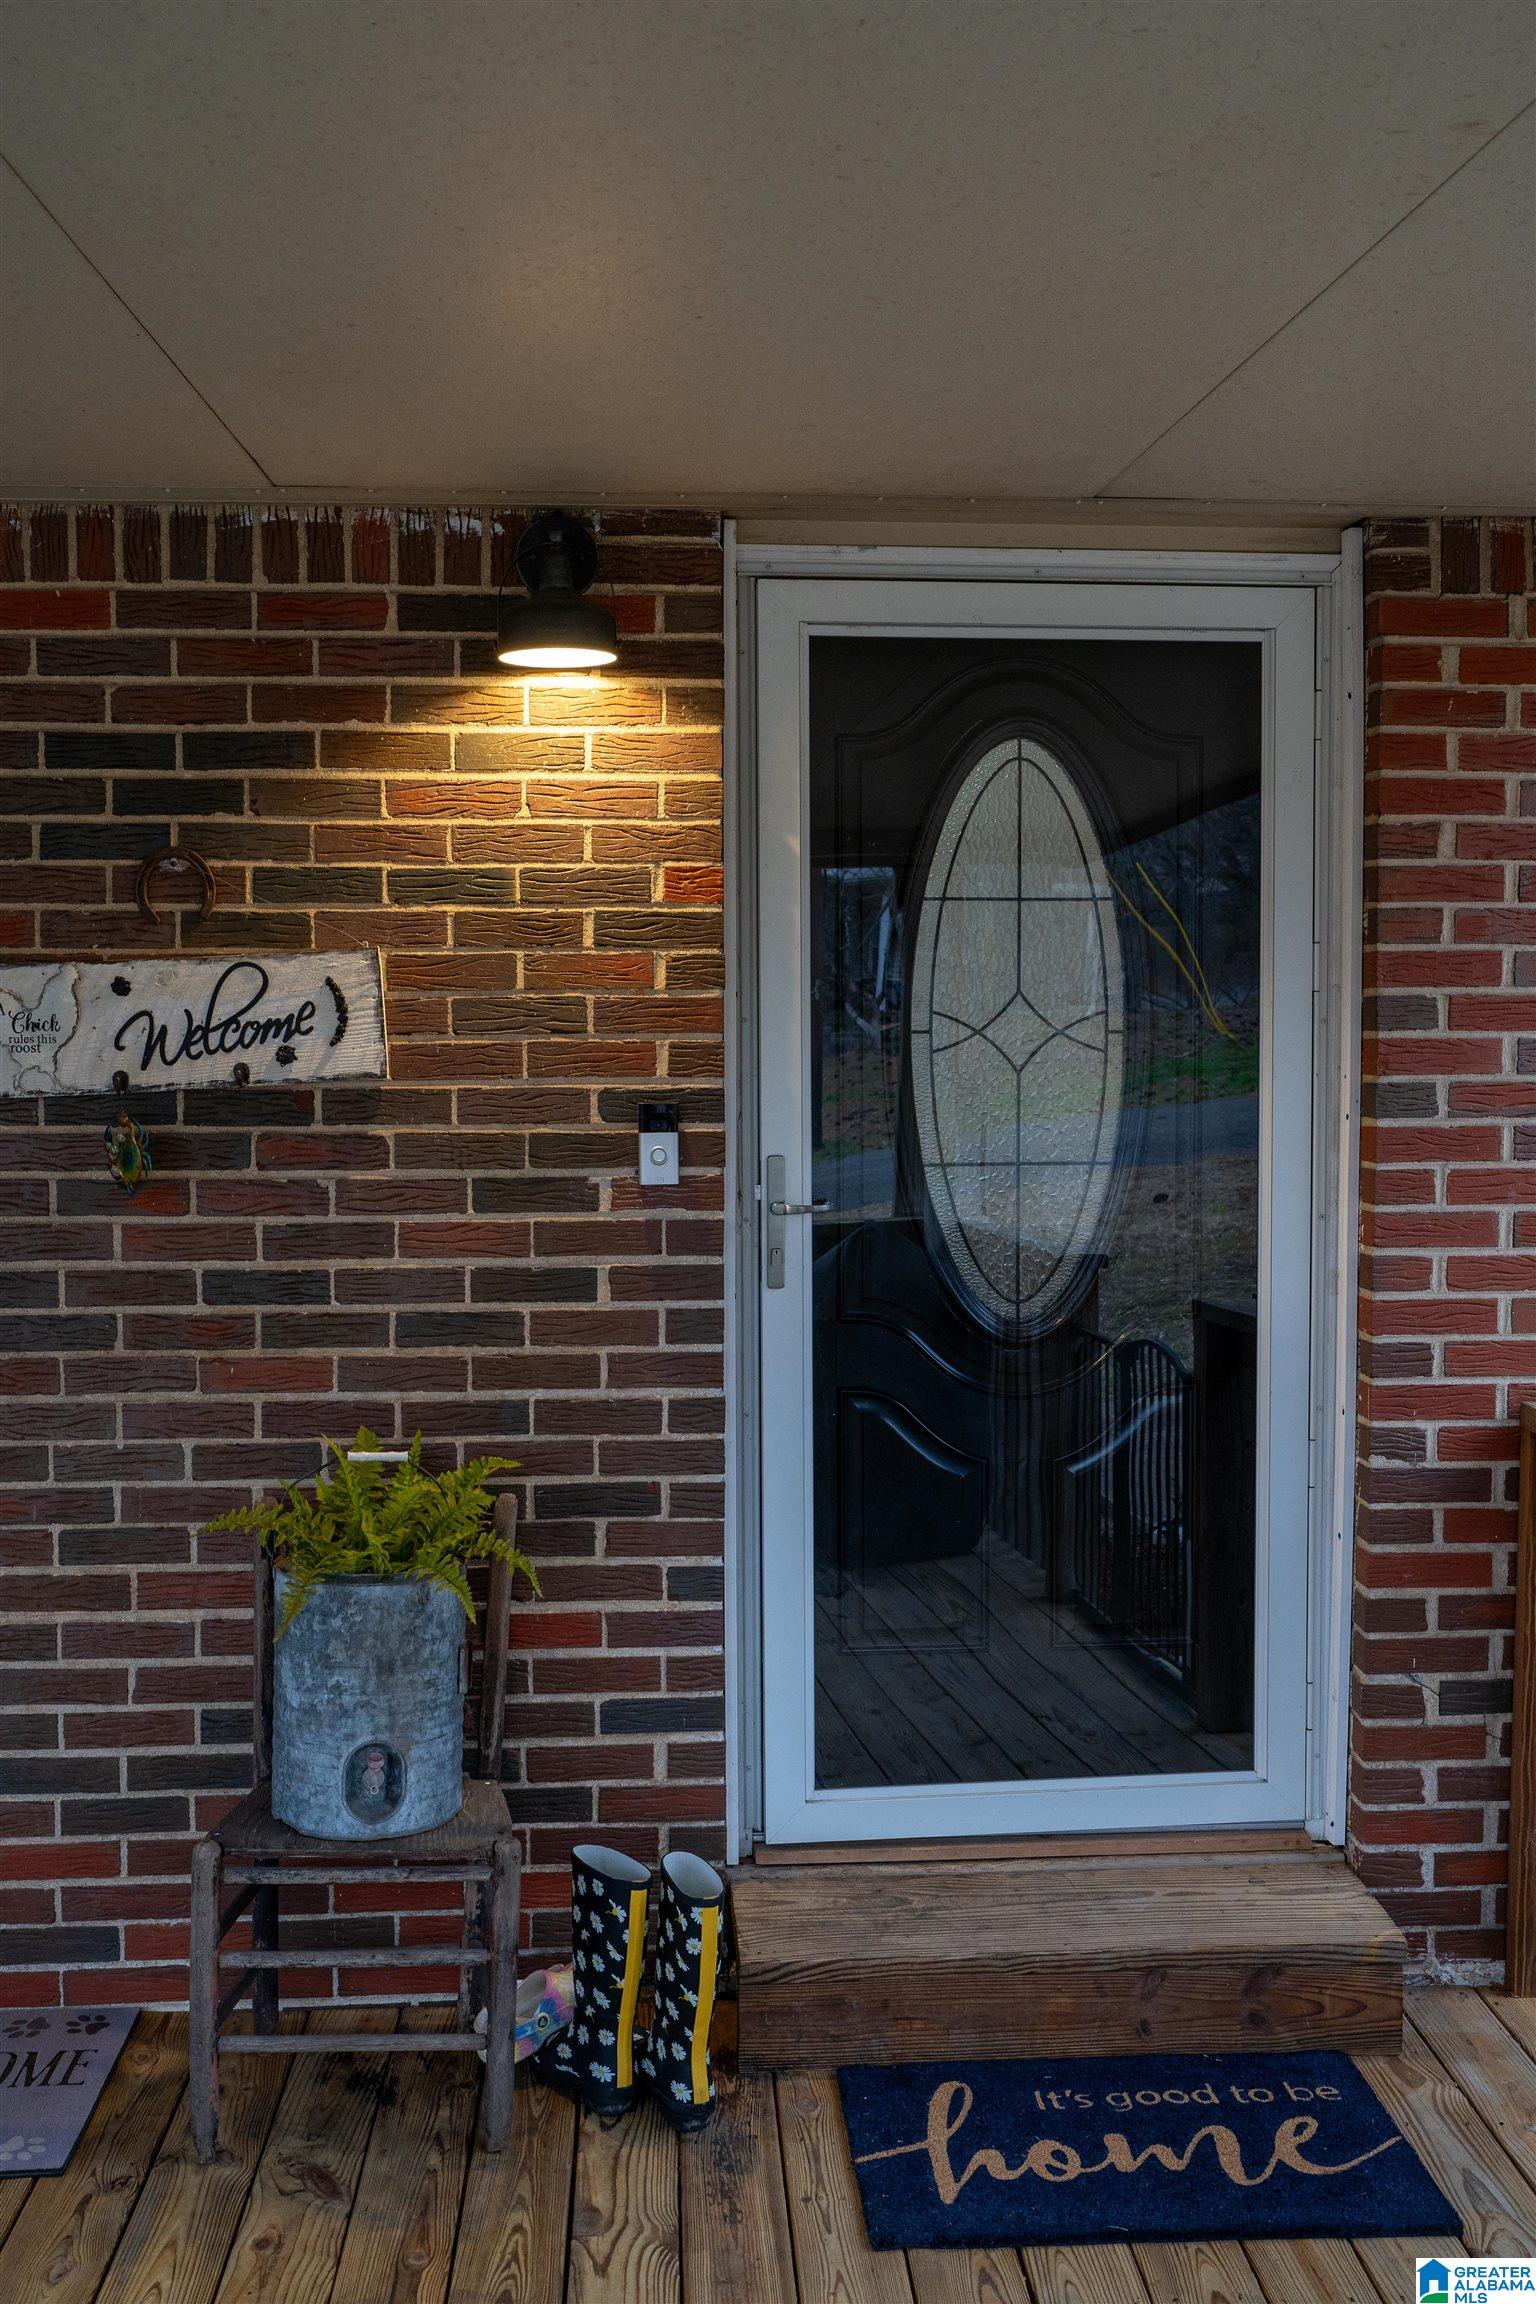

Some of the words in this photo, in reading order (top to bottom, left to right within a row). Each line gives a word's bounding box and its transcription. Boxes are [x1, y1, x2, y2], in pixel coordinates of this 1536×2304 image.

[8, 1010, 61, 1034] Chick
[115, 961, 316, 1071] Welcome
[8, 1034, 35, 1044] rules
[37, 1034, 57, 1044] this
[10, 1044, 42, 1053] roost
[1034, 2089, 1094, 2110] It's
[1105, 2083, 1220, 2112] good
[1229, 2084, 1275, 2103] to
[1282, 2081, 1342, 2101] be
[855, 2081, 1402, 2204] home
